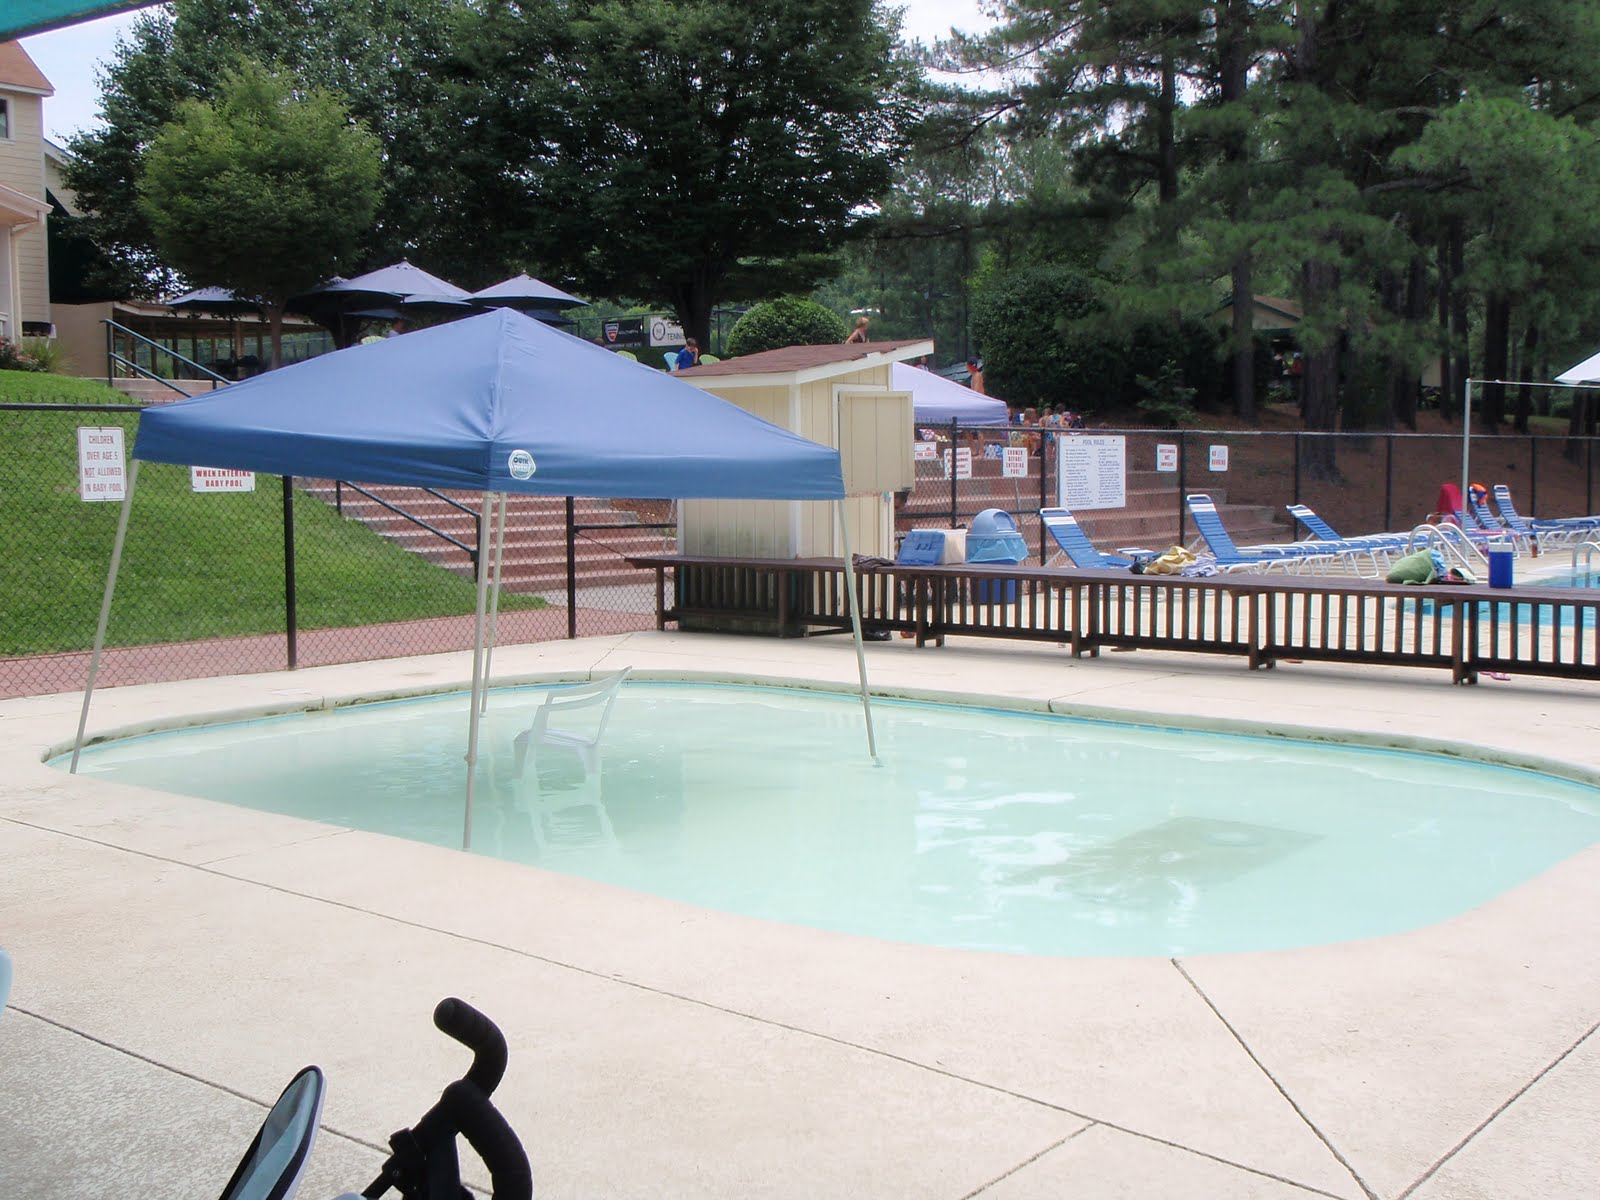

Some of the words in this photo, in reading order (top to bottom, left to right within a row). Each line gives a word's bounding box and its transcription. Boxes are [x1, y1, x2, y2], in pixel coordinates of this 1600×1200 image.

[88, 435, 114, 445] CHILDREN
[86, 451, 100, 460] OVER
[102, 451, 113, 460] AGE
[114, 451, 118, 460] 5
[84, 467, 95, 477] NOT
[97, 467, 122, 476] ALLOWED
[196, 469, 216, 477] WHEN
[218, 469, 251, 477] ENTERING
[85, 483, 91, 492] IN
[93, 483, 107, 492] BABY
[109, 483, 123, 492] POOL
